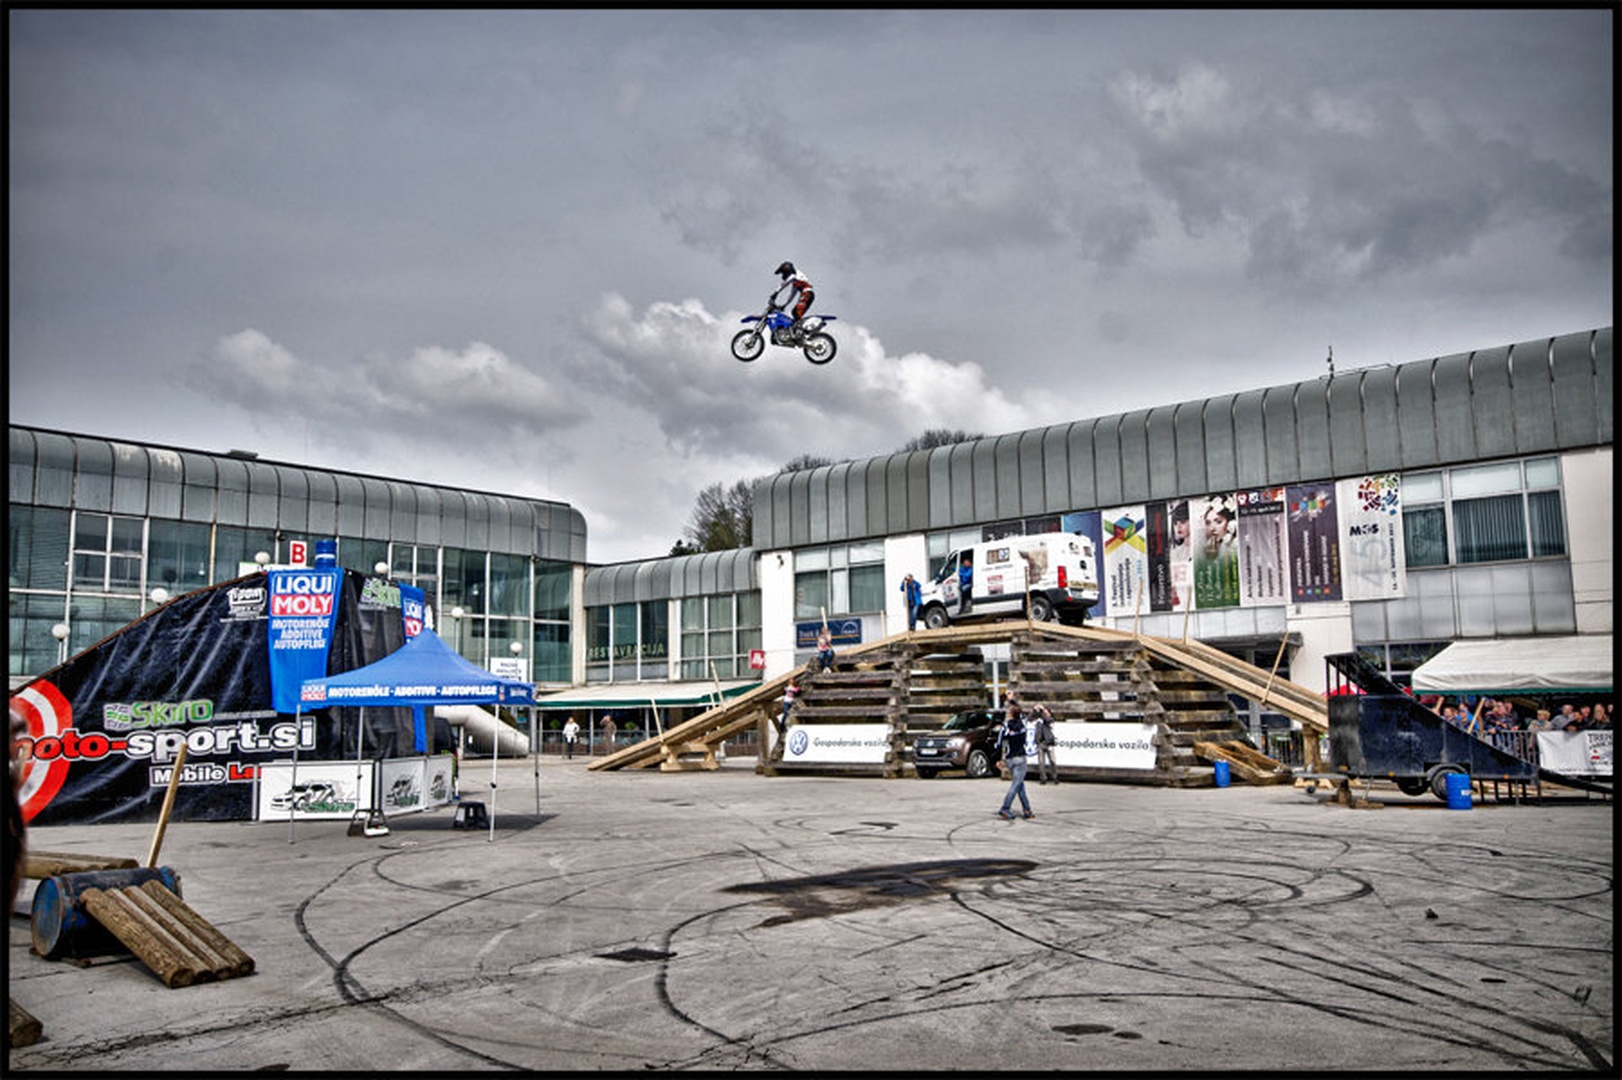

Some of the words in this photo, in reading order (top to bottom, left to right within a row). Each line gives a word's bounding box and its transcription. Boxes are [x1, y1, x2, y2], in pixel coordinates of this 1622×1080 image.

[292, 543, 305, 563] B
[276, 576, 332, 595] LIQUI
[273, 595, 331, 614] MOLY
[272, 617, 330, 630] MOTORENÖLE
[281, 629, 323, 640] ADDITIVE
[274, 639, 327, 650] AUTOPFLEGE
[394, 685, 437, 697] ADDITIVE
[1119, 740, 1150, 750] vozila
[153, 767, 225, 783] Mbile
